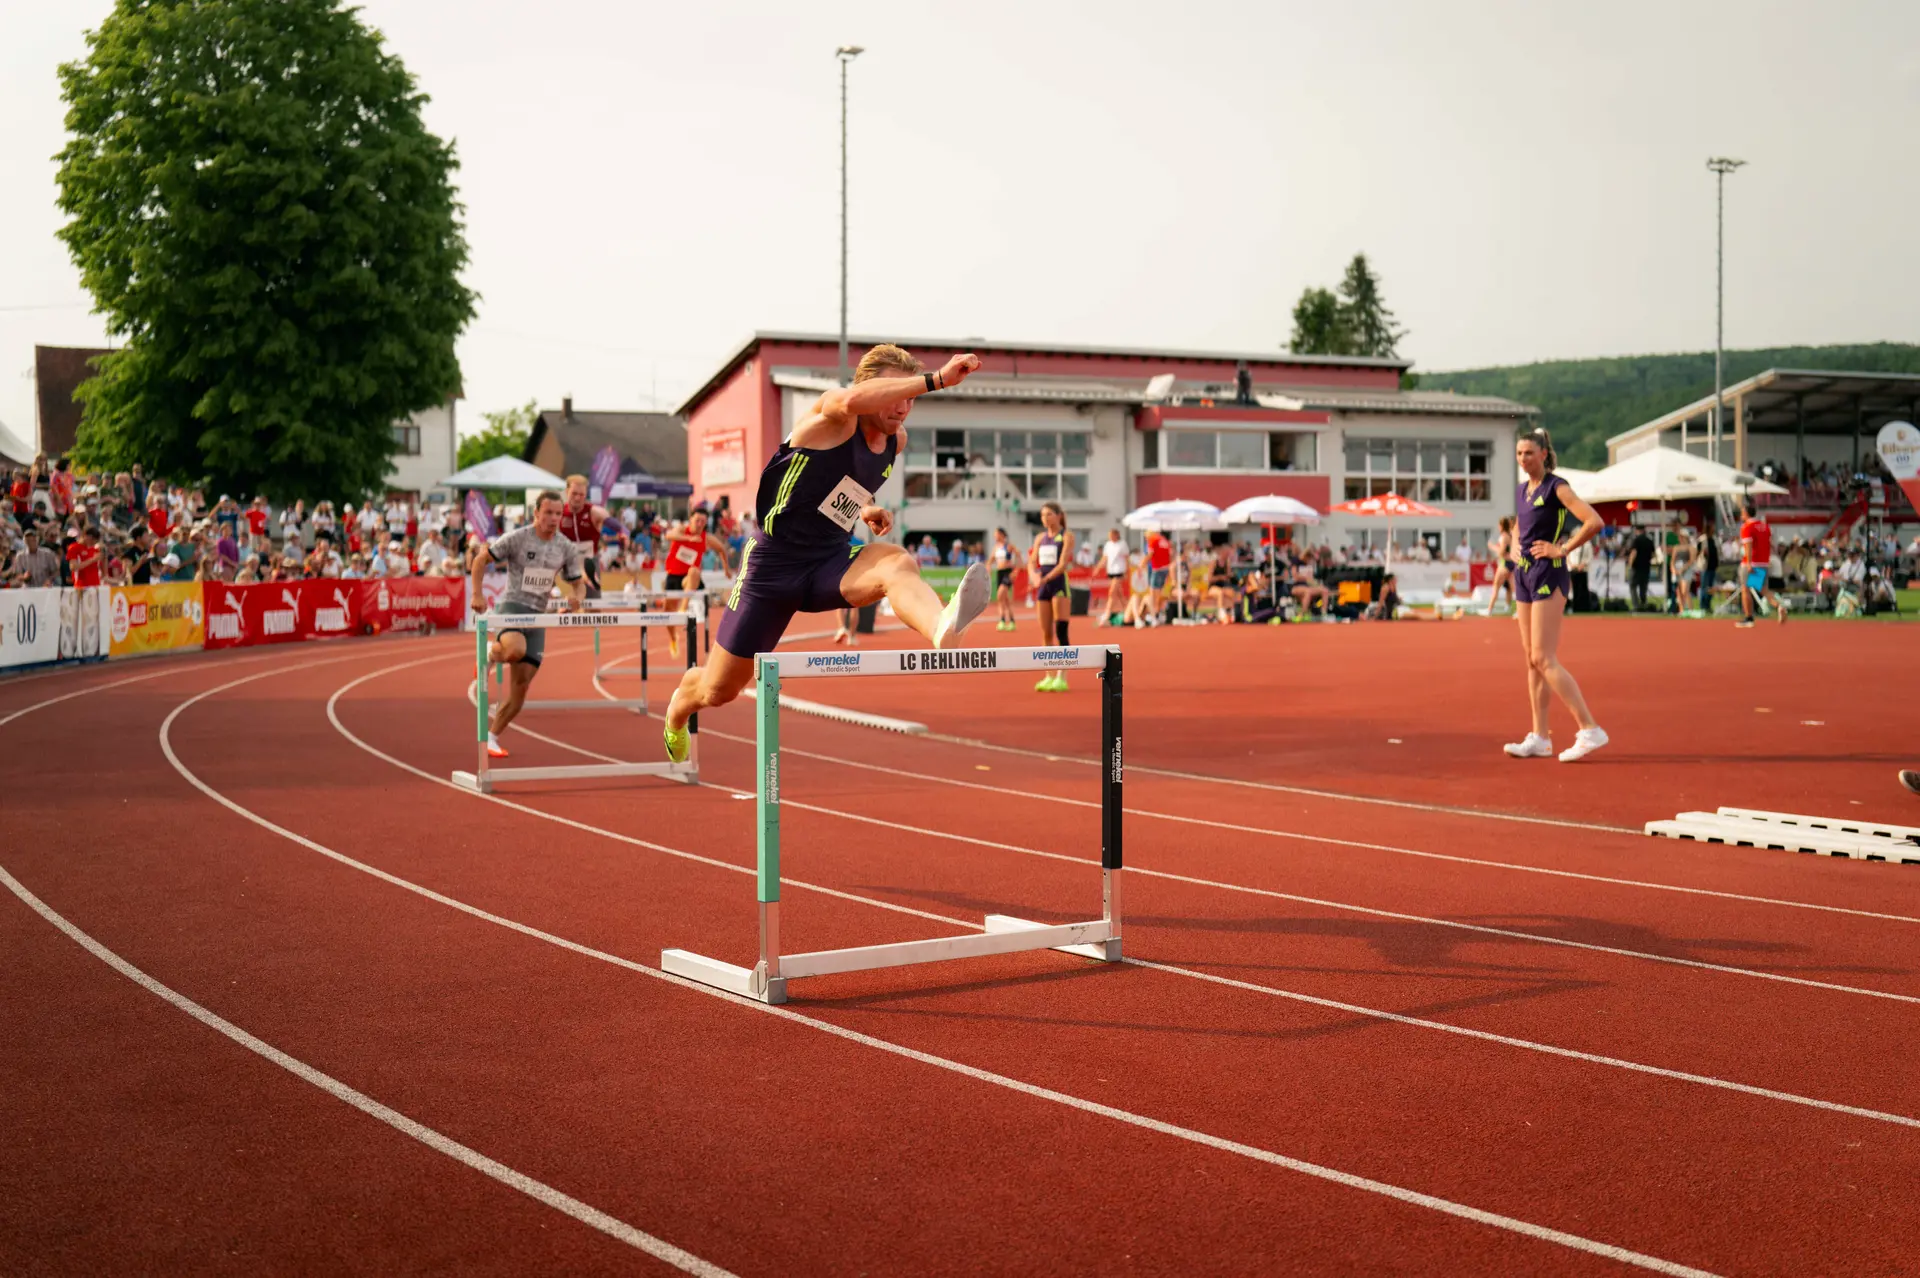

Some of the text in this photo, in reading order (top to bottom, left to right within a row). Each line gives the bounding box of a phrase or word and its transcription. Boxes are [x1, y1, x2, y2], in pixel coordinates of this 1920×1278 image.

[559, 614, 619, 625] LC REHLINGEN
[807, 653, 860, 666] vennekel
[1032, 647, 1079, 660] vennekel
[900, 651, 997, 671] LC REHLINGEN
[1065, 659, 1079, 667] Sport
[845, 665, 860, 674] Sport
[1115, 736, 1123, 784] vennekel
[770, 752, 779, 804] vennekel
